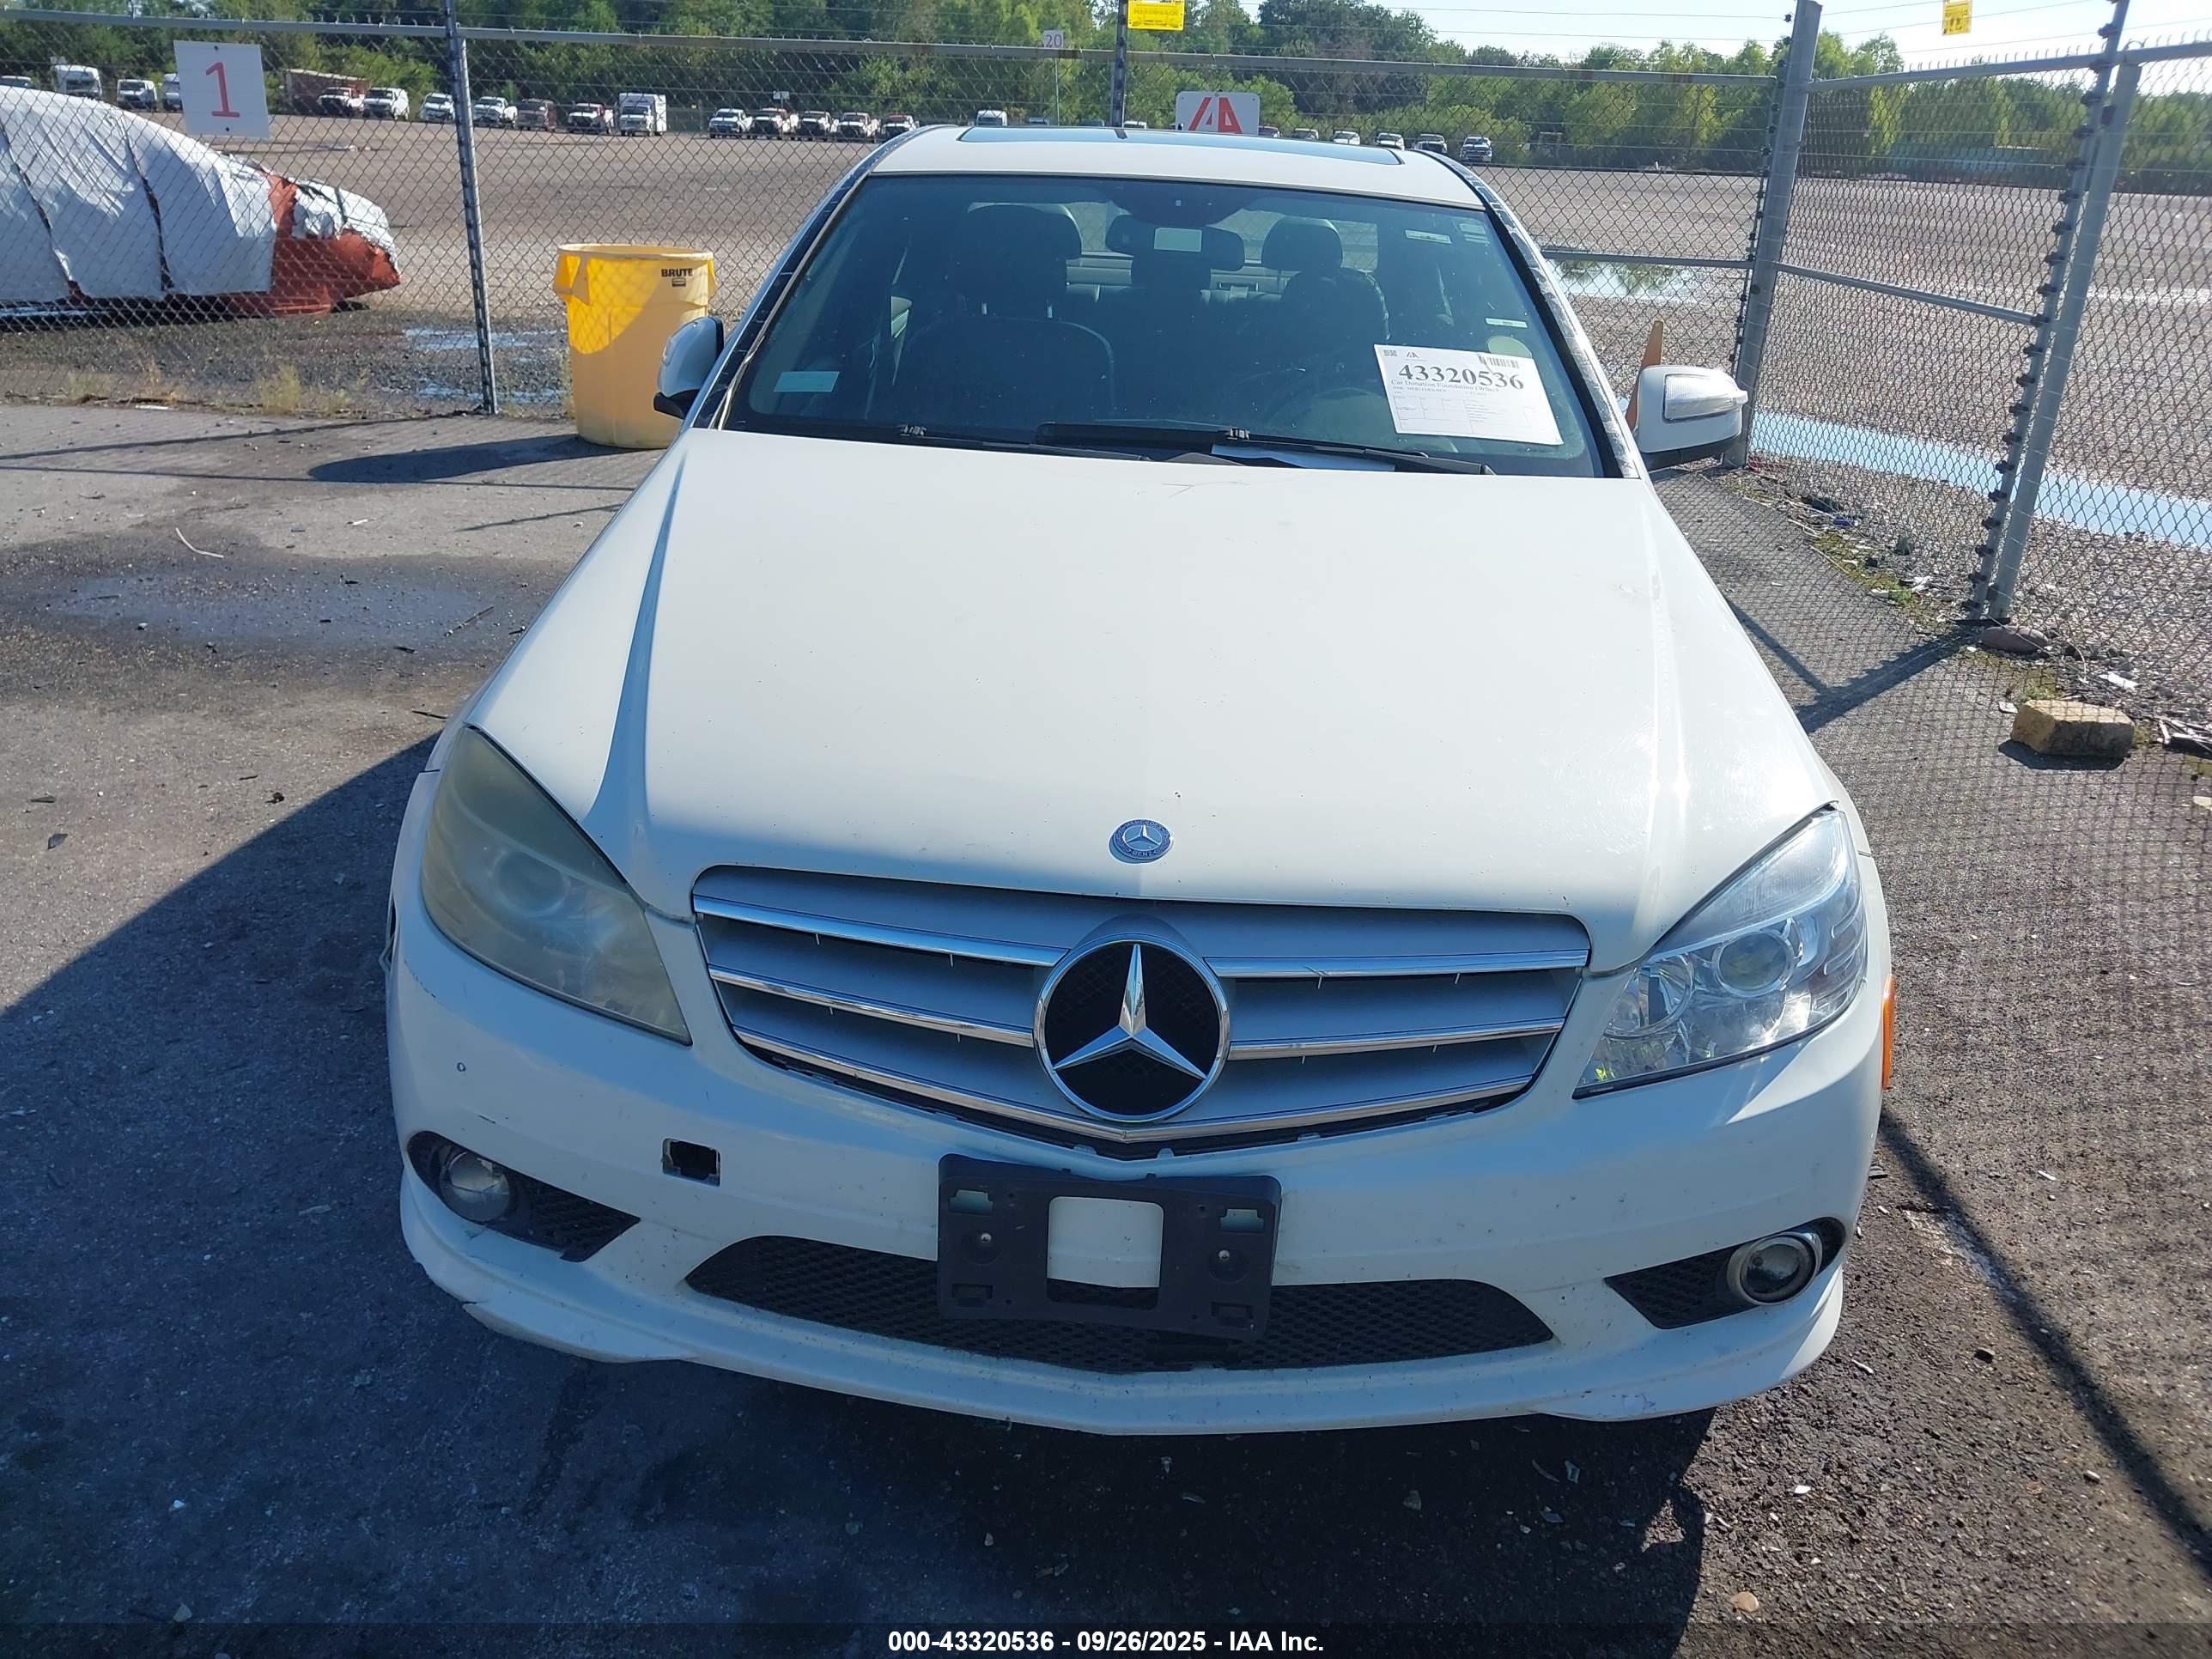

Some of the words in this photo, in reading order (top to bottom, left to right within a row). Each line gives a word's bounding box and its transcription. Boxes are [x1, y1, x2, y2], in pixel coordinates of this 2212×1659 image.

[1045, 33, 1062, 48] 20
[206, 62, 240, 118] 1
[661, 268, 693, 277] BRUTE
[1399, 364, 1524, 390] 43320536
